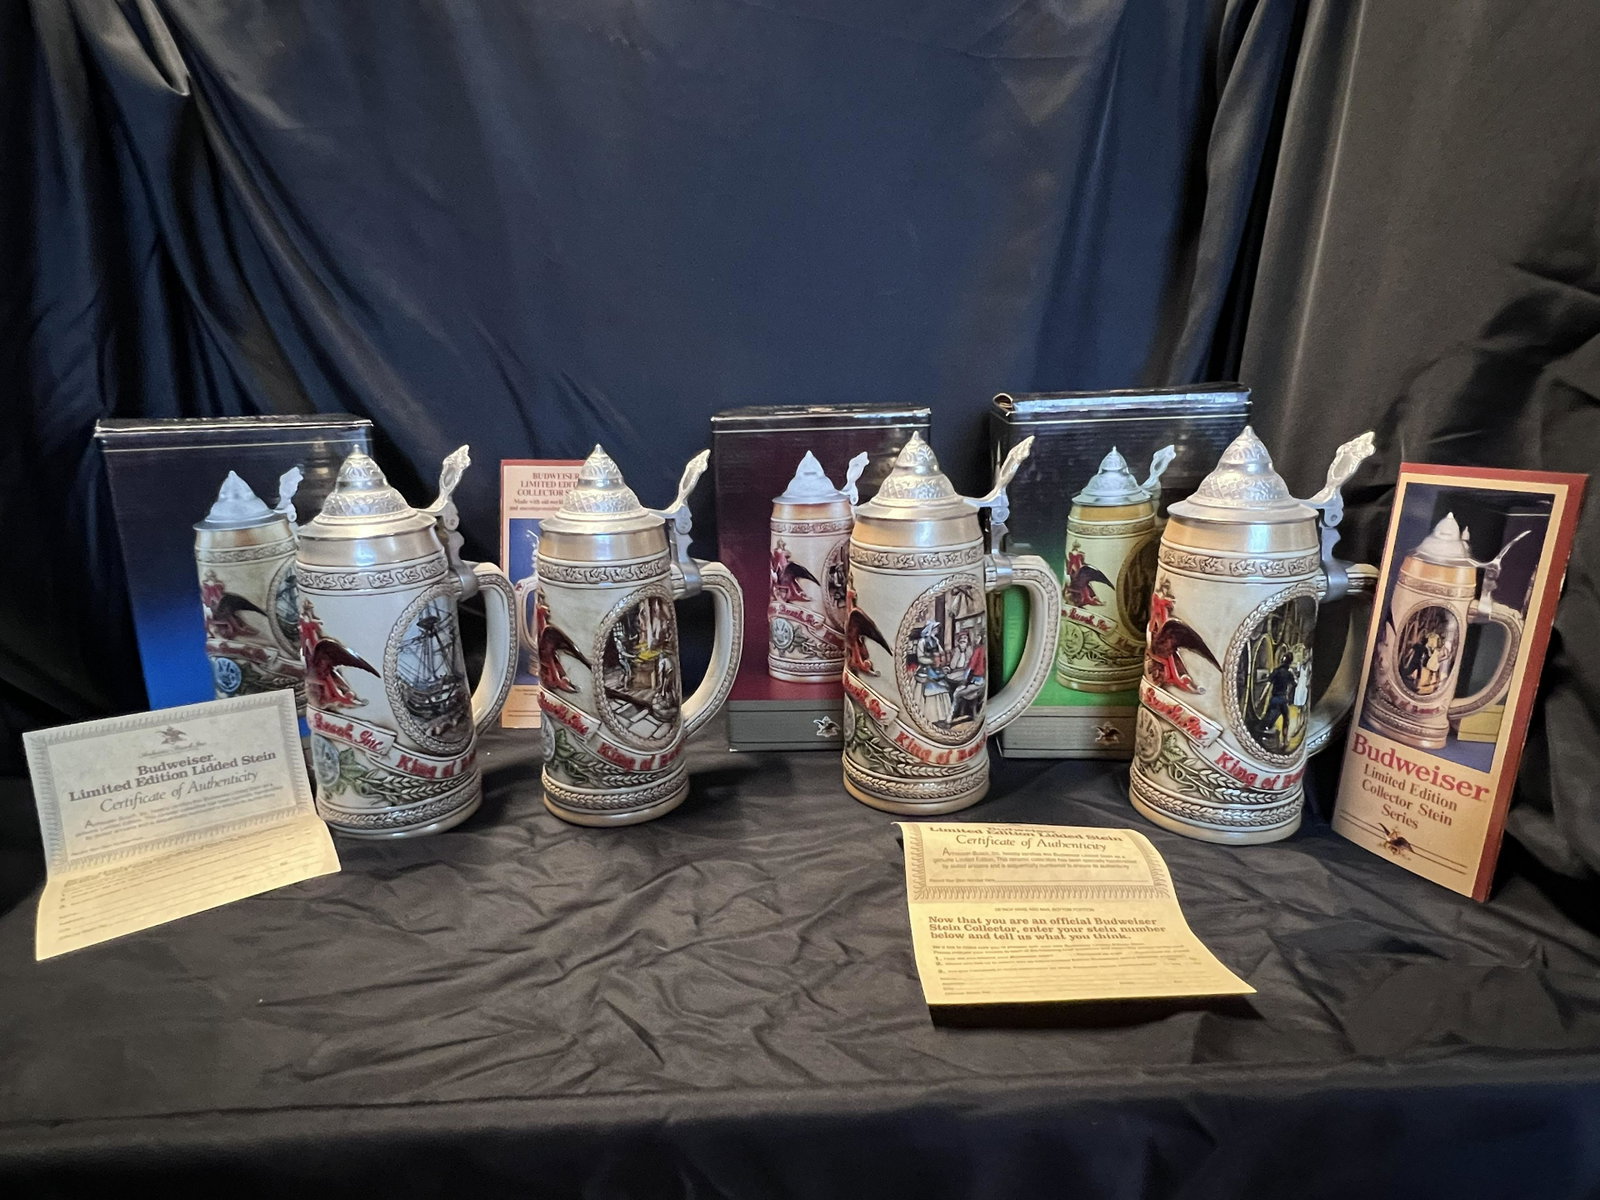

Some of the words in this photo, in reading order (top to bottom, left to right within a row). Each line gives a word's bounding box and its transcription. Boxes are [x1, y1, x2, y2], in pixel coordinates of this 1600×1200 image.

[597, 742, 636, 771] King
[640, 754, 656, 771] of
[895, 731, 932, 763] King
[937, 749, 953, 765] of
[69, 780, 132, 802] Limited
[135, 769, 188, 788] Edition
[192, 759, 238, 776] Lidded
[241, 751, 276, 766] Stein
[137, 753, 214, 776] Budweiser
[396, 754, 437, 780] King
[442, 760, 456, 778] of
[1215, 751, 1258, 787] King
[1261, 774, 1280, 789] of
[1352, 732, 1490, 801] Budweiser
[100, 790, 166, 812] Certificate
[171, 782, 185, 799] of
[187, 770, 258, 794] Authenticity
[1364, 763, 1406, 791] Limited
[1410, 782, 1458, 811] Edition
[1362, 778, 1413, 810] Collector
[1418, 804, 1453, 826] Stein
[1381, 804, 1419, 830] Series
[956, 834, 1016, 848] Certificate
[1021, 838, 1032, 849] of
[1037, 838, 1106, 852] Authenticity
[986, 829, 1035, 837] Edition
[1037, 831, 1084, 839] Lidded
[964, 924, 1020, 933] Collector,
[1057, 926, 1083, 934] your
[985, 918, 1006, 926] you
[1049, 917, 1091, 925] official
[1094, 917, 1157, 925] Budweiser
